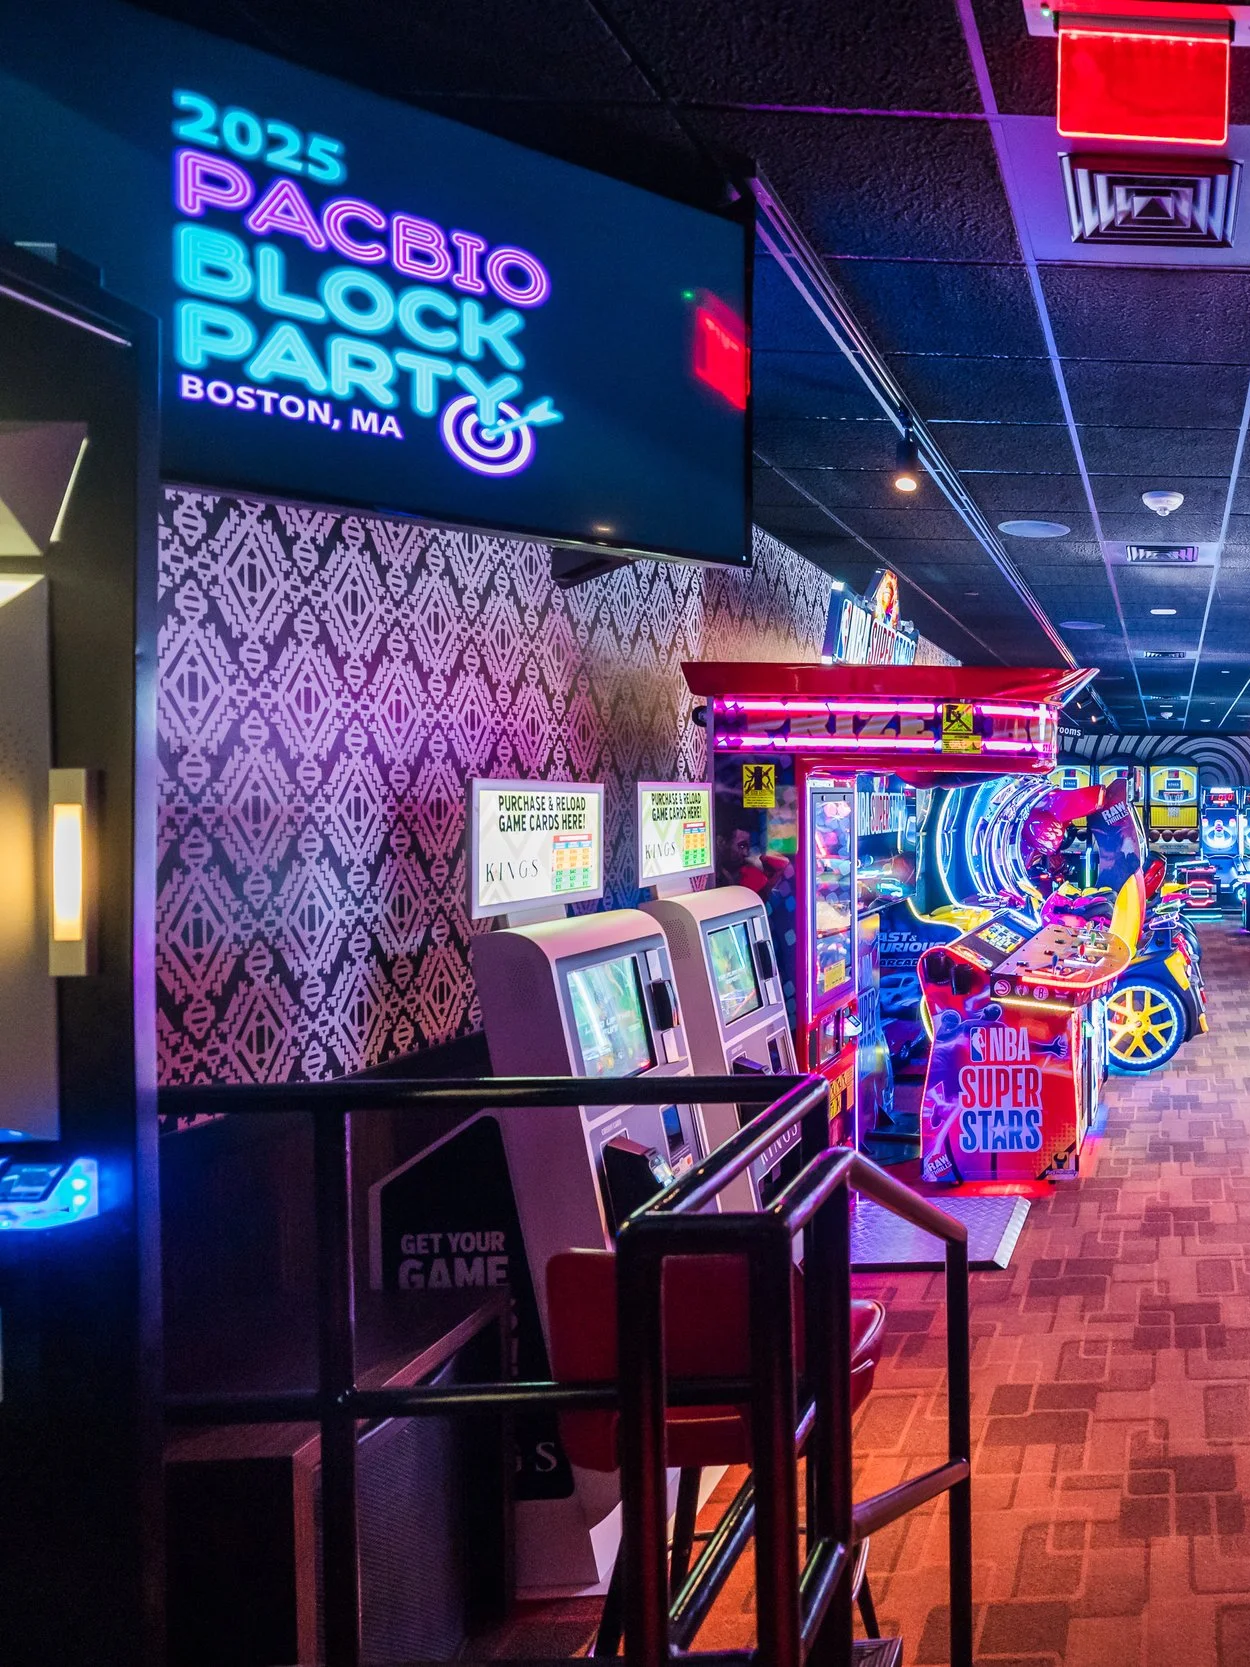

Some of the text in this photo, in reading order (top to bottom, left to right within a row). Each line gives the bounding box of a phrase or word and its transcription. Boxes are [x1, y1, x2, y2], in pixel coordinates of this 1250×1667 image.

[175, 93, 345, 182] 2025
[177, 150, 549, 307] PACBIO
[178, 224, 522, 368] BLOCK
[178, 302, 520, 426] PARTY
[180, 374, 402, 438] BOSTON, MA
[498, 795, 586, 812] PURCHASE & RELOAD
[651, 792, 678, 806] PURCHASE
[684, 792, 702, 804] RELOAD
[651, 805, 702, 822] GAME CARDS HERE!
[1101, 800, 1127, 821] RAW
[498, 813, 586, 833] GAME CARDS HERE!
[1105, 807, 1130, 827] THRILLS
[485, 859, 539, 883] KINGS
[879, 931, 911, 942] AST
[989, 1027, 1031, 1062] NBA
[961, 1067, 1041, 1110] SUPER
[961, 1109, 1041, 1152] STARS
[400, 1231, 506, 1255] GET YOUR
[398, 1255, 511, 1290] GAME
